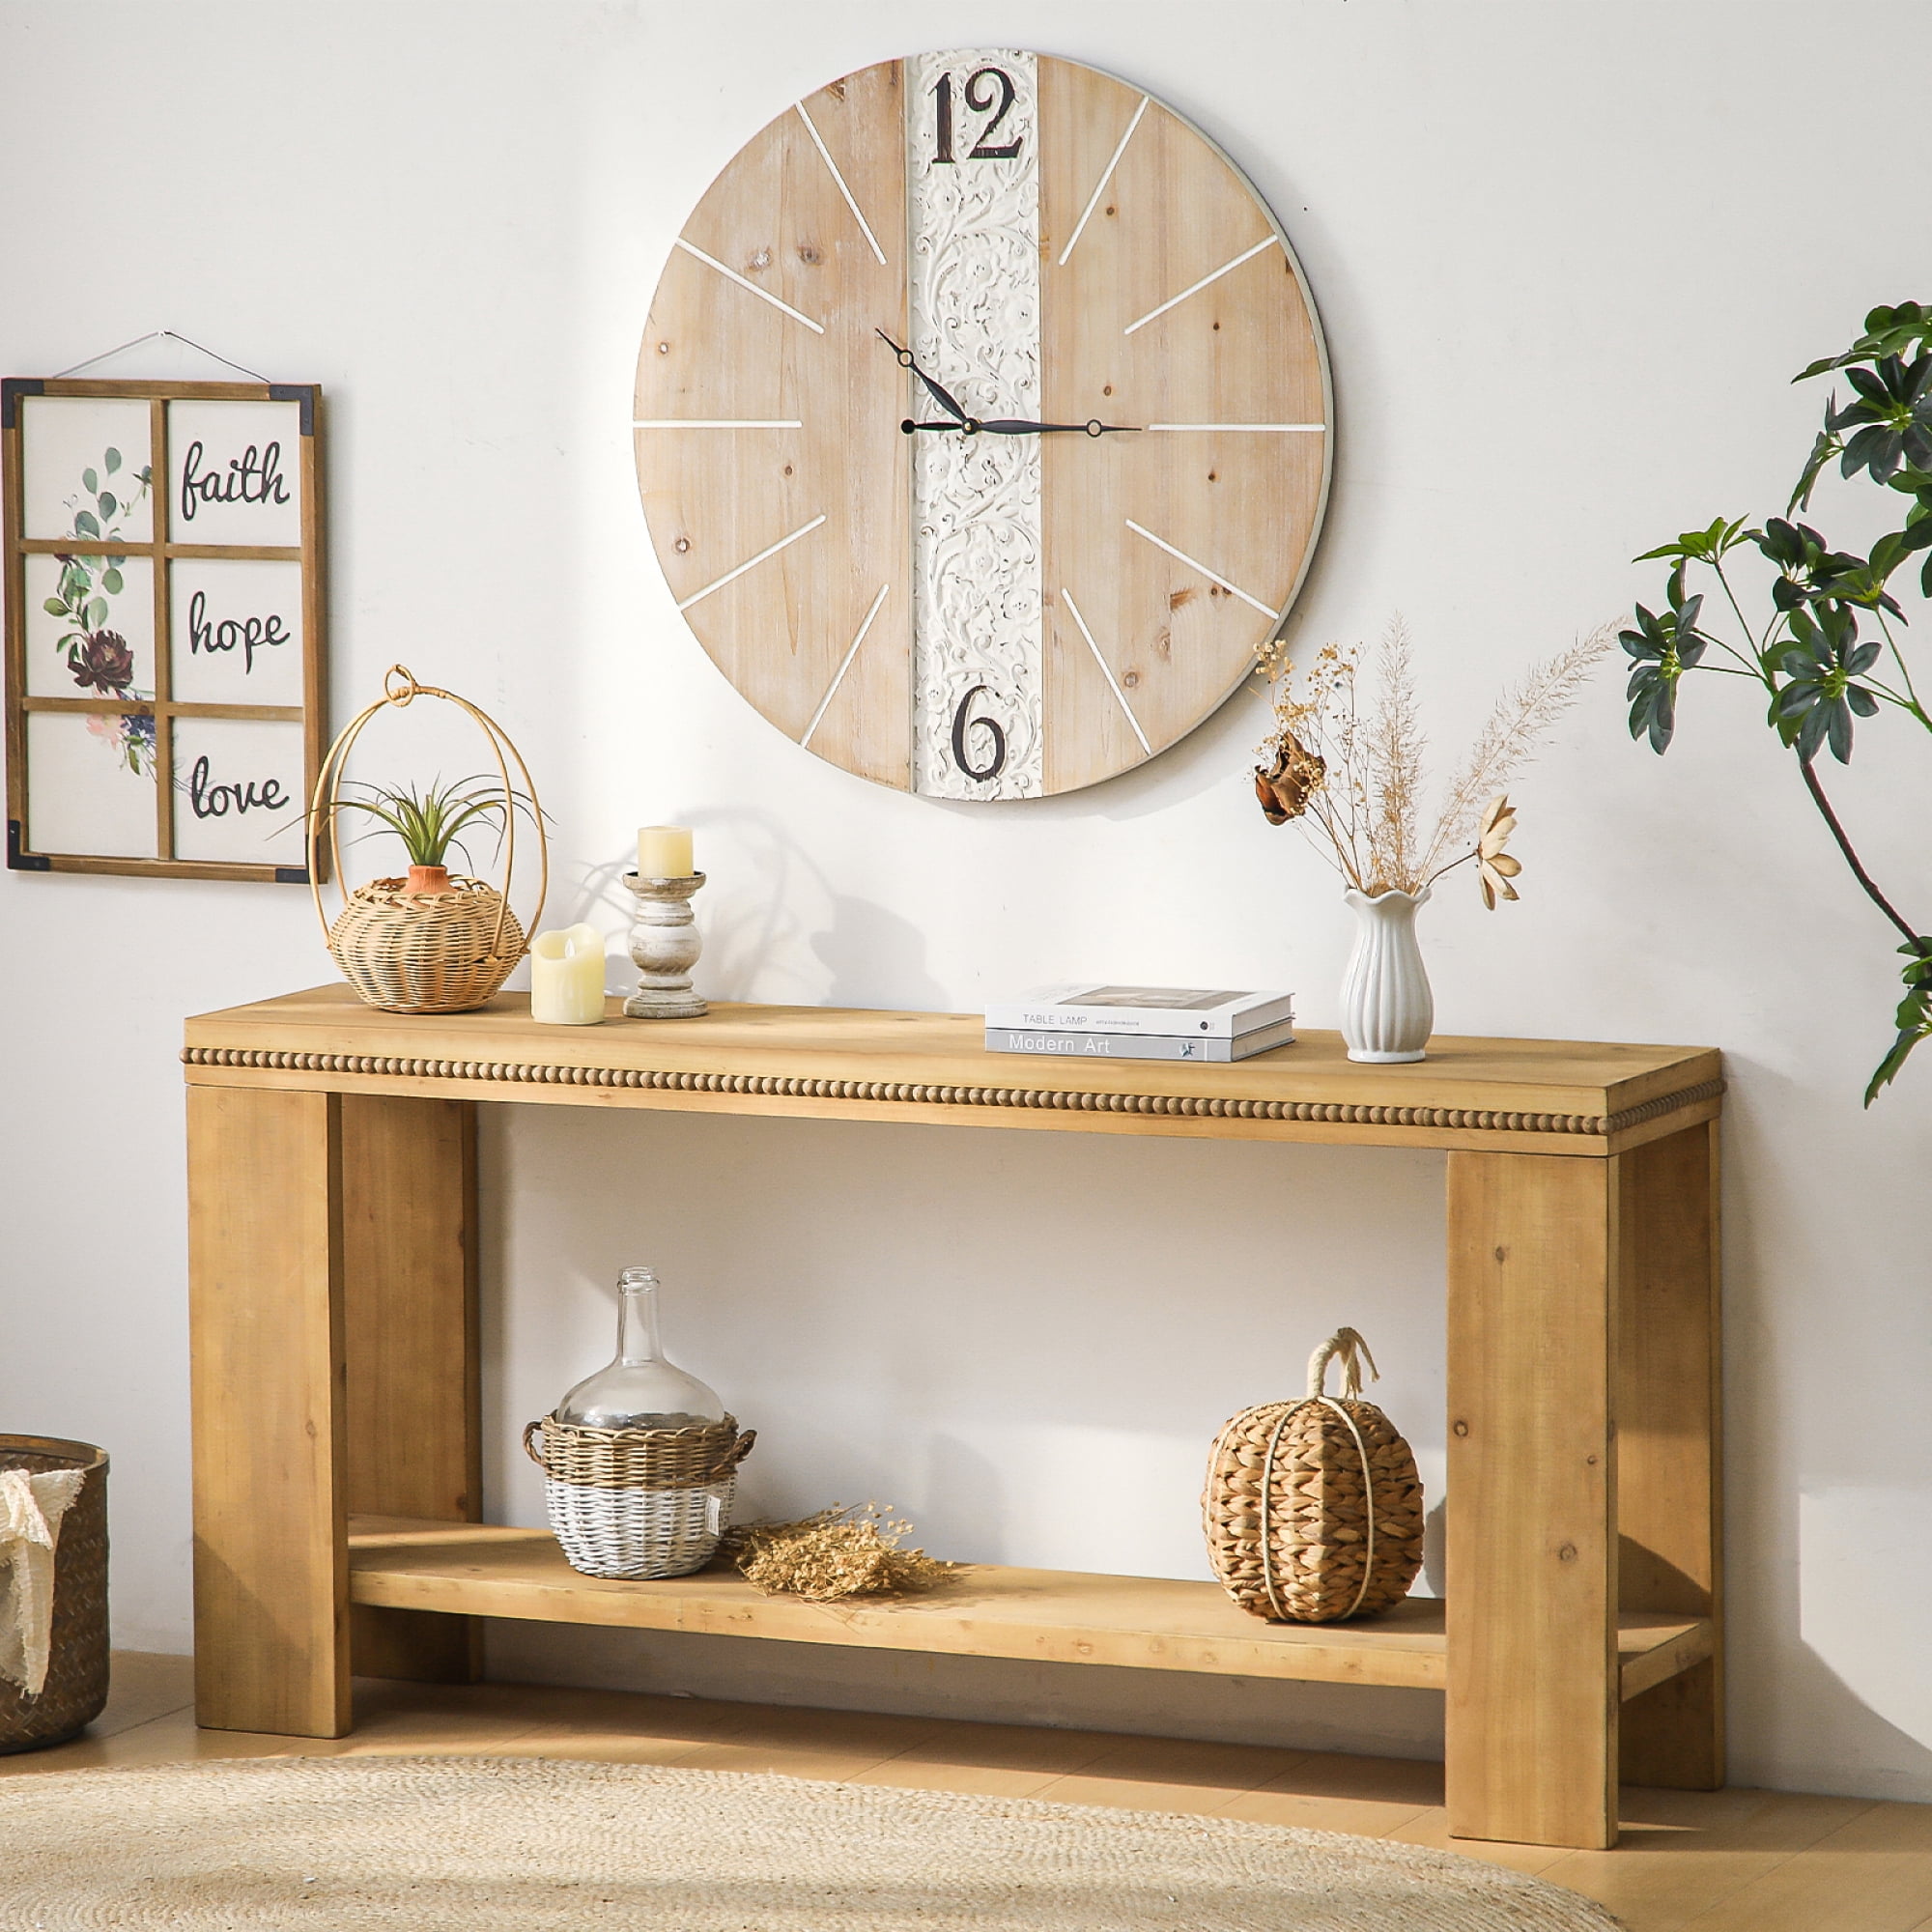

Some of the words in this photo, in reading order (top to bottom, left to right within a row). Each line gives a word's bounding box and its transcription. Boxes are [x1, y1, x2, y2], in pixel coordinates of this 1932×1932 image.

[927, 67, 1024, 164] 12
[182, 440, 290, 521] faith
[189, 590, 290, 675] hope
[952, 684, 1006, 783] 6
[191, 754, 290, 819] love
[1009, 1034, 1074, 1052] Modern
[1085, 1037, 1111, 1054] Art
[1023, 1013, 1055, 1025] TABLE
[1059, 1015, 1088, 1026] LAMP
